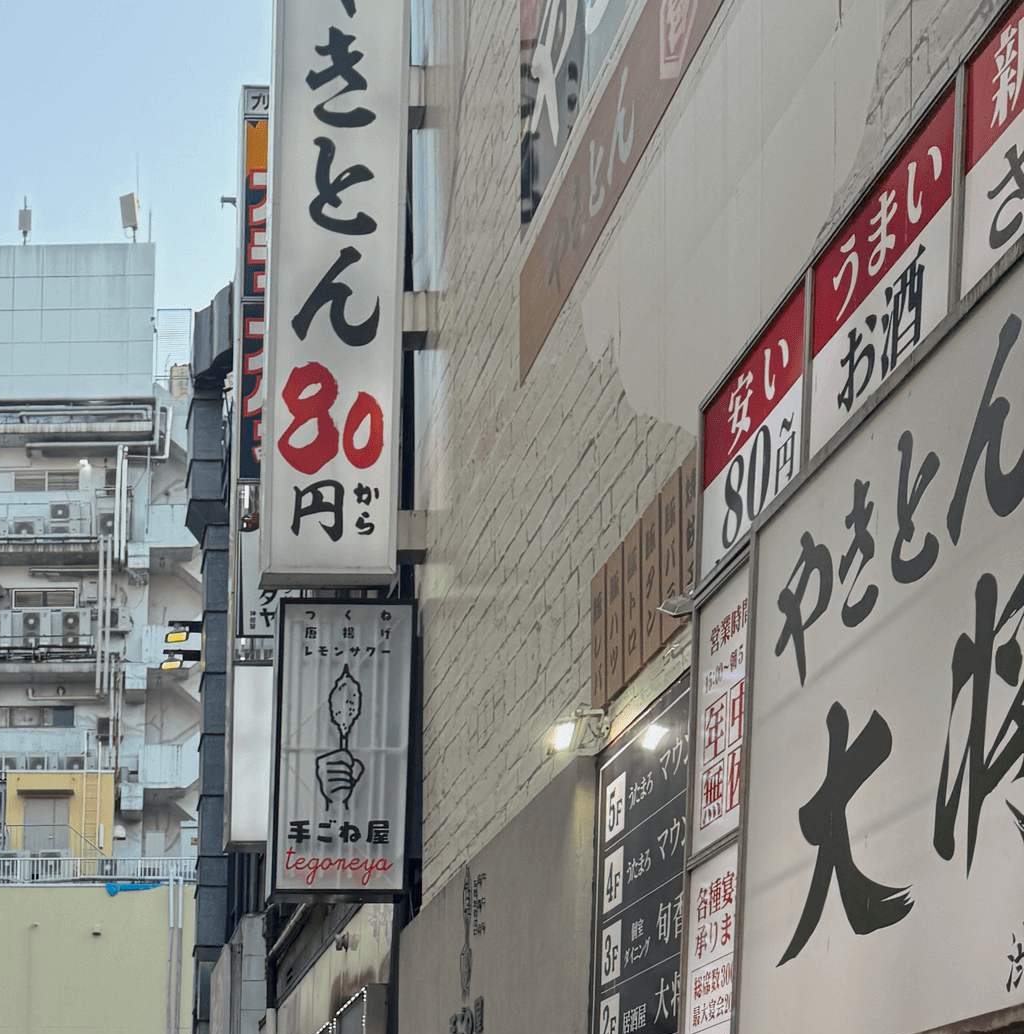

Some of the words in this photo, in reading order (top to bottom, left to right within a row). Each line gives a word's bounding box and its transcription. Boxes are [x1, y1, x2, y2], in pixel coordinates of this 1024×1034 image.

[291, 0, 379, 346] きとん
[833, 146, 942, 321] うまい
[838, 245, 926, 412] お酒
[277, 361, 384, 475] 80
[727, 339, 789, 456] 安い
[290, 480, 344, 542] 円
[305, 609, 392, 621] つくね
[305, 626, 391, 640] 唐揚げ
[305, 646, 391, 656] レモンサワー
[608, 786, 623, 833] 5F
[628, 771, 654, 810] うたまろ
[287, 819, 391, 844] 手ごね屋
[285, 846, 393, 885] tegoneya
[606, 861, 621, 904] 4F
[626, 848, 652, 885] うたまろ
[604, 933, 619, 977] 3F
[622, 1003, 647, 1034] 居酒屋
